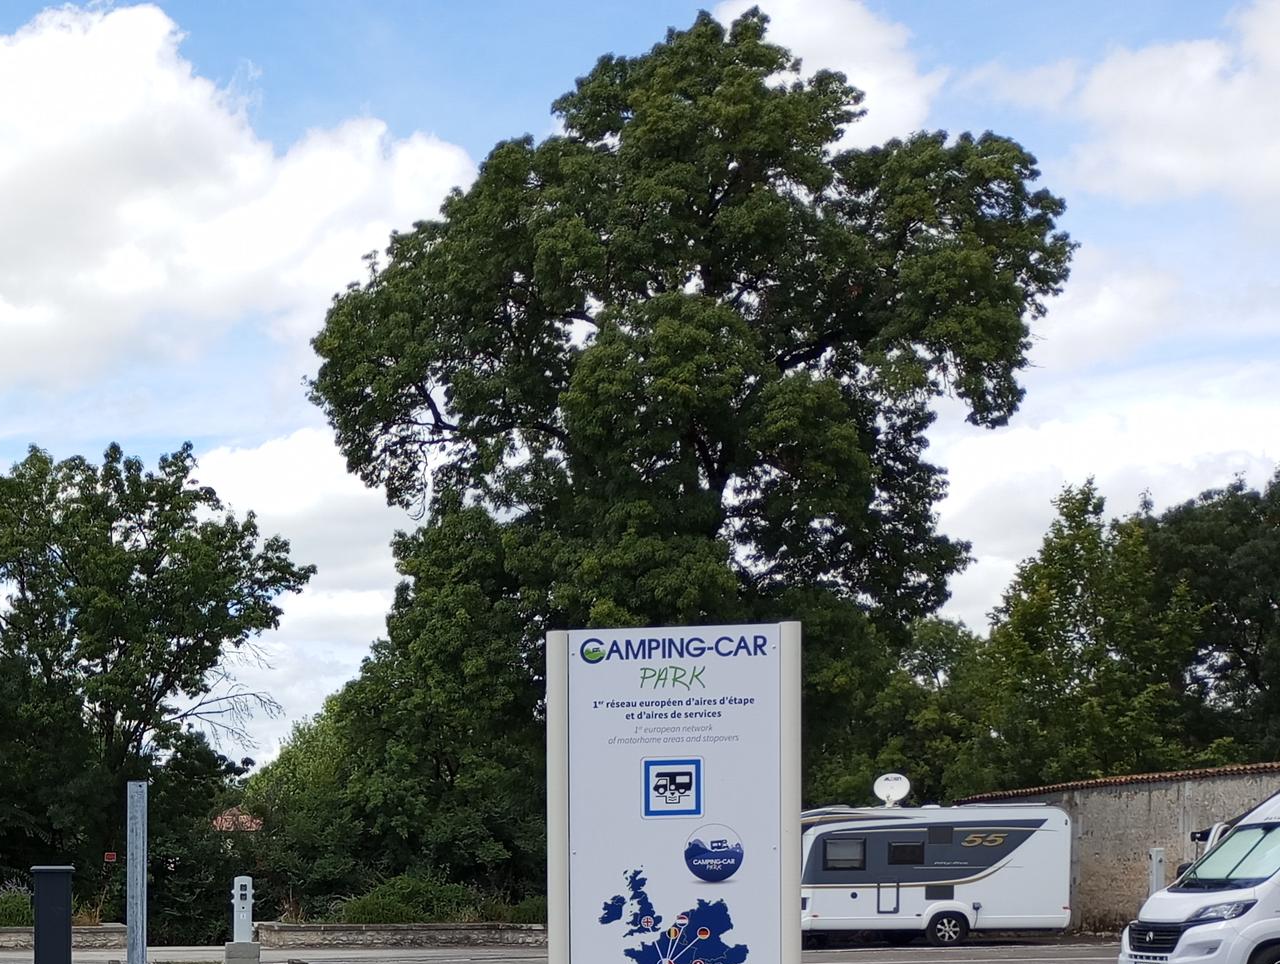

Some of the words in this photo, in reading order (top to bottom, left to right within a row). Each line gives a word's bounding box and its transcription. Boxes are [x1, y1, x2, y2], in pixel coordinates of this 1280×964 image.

[580, 635, 767, 664] CAMPING-CAR
[640, 666, 706, 691] PARK
[639, 699, 683, 708] européen
[686, 698, 717, 706] d'aires
[720, 697, 755, 706] d'étape
[637, 711, 668, 719] d'aires
[671, 711, 681, 719] de
[682, 724, 712, 732] network
[703, 735, 739, 743] stopovers
[961, 834, 1008, 847] 55
